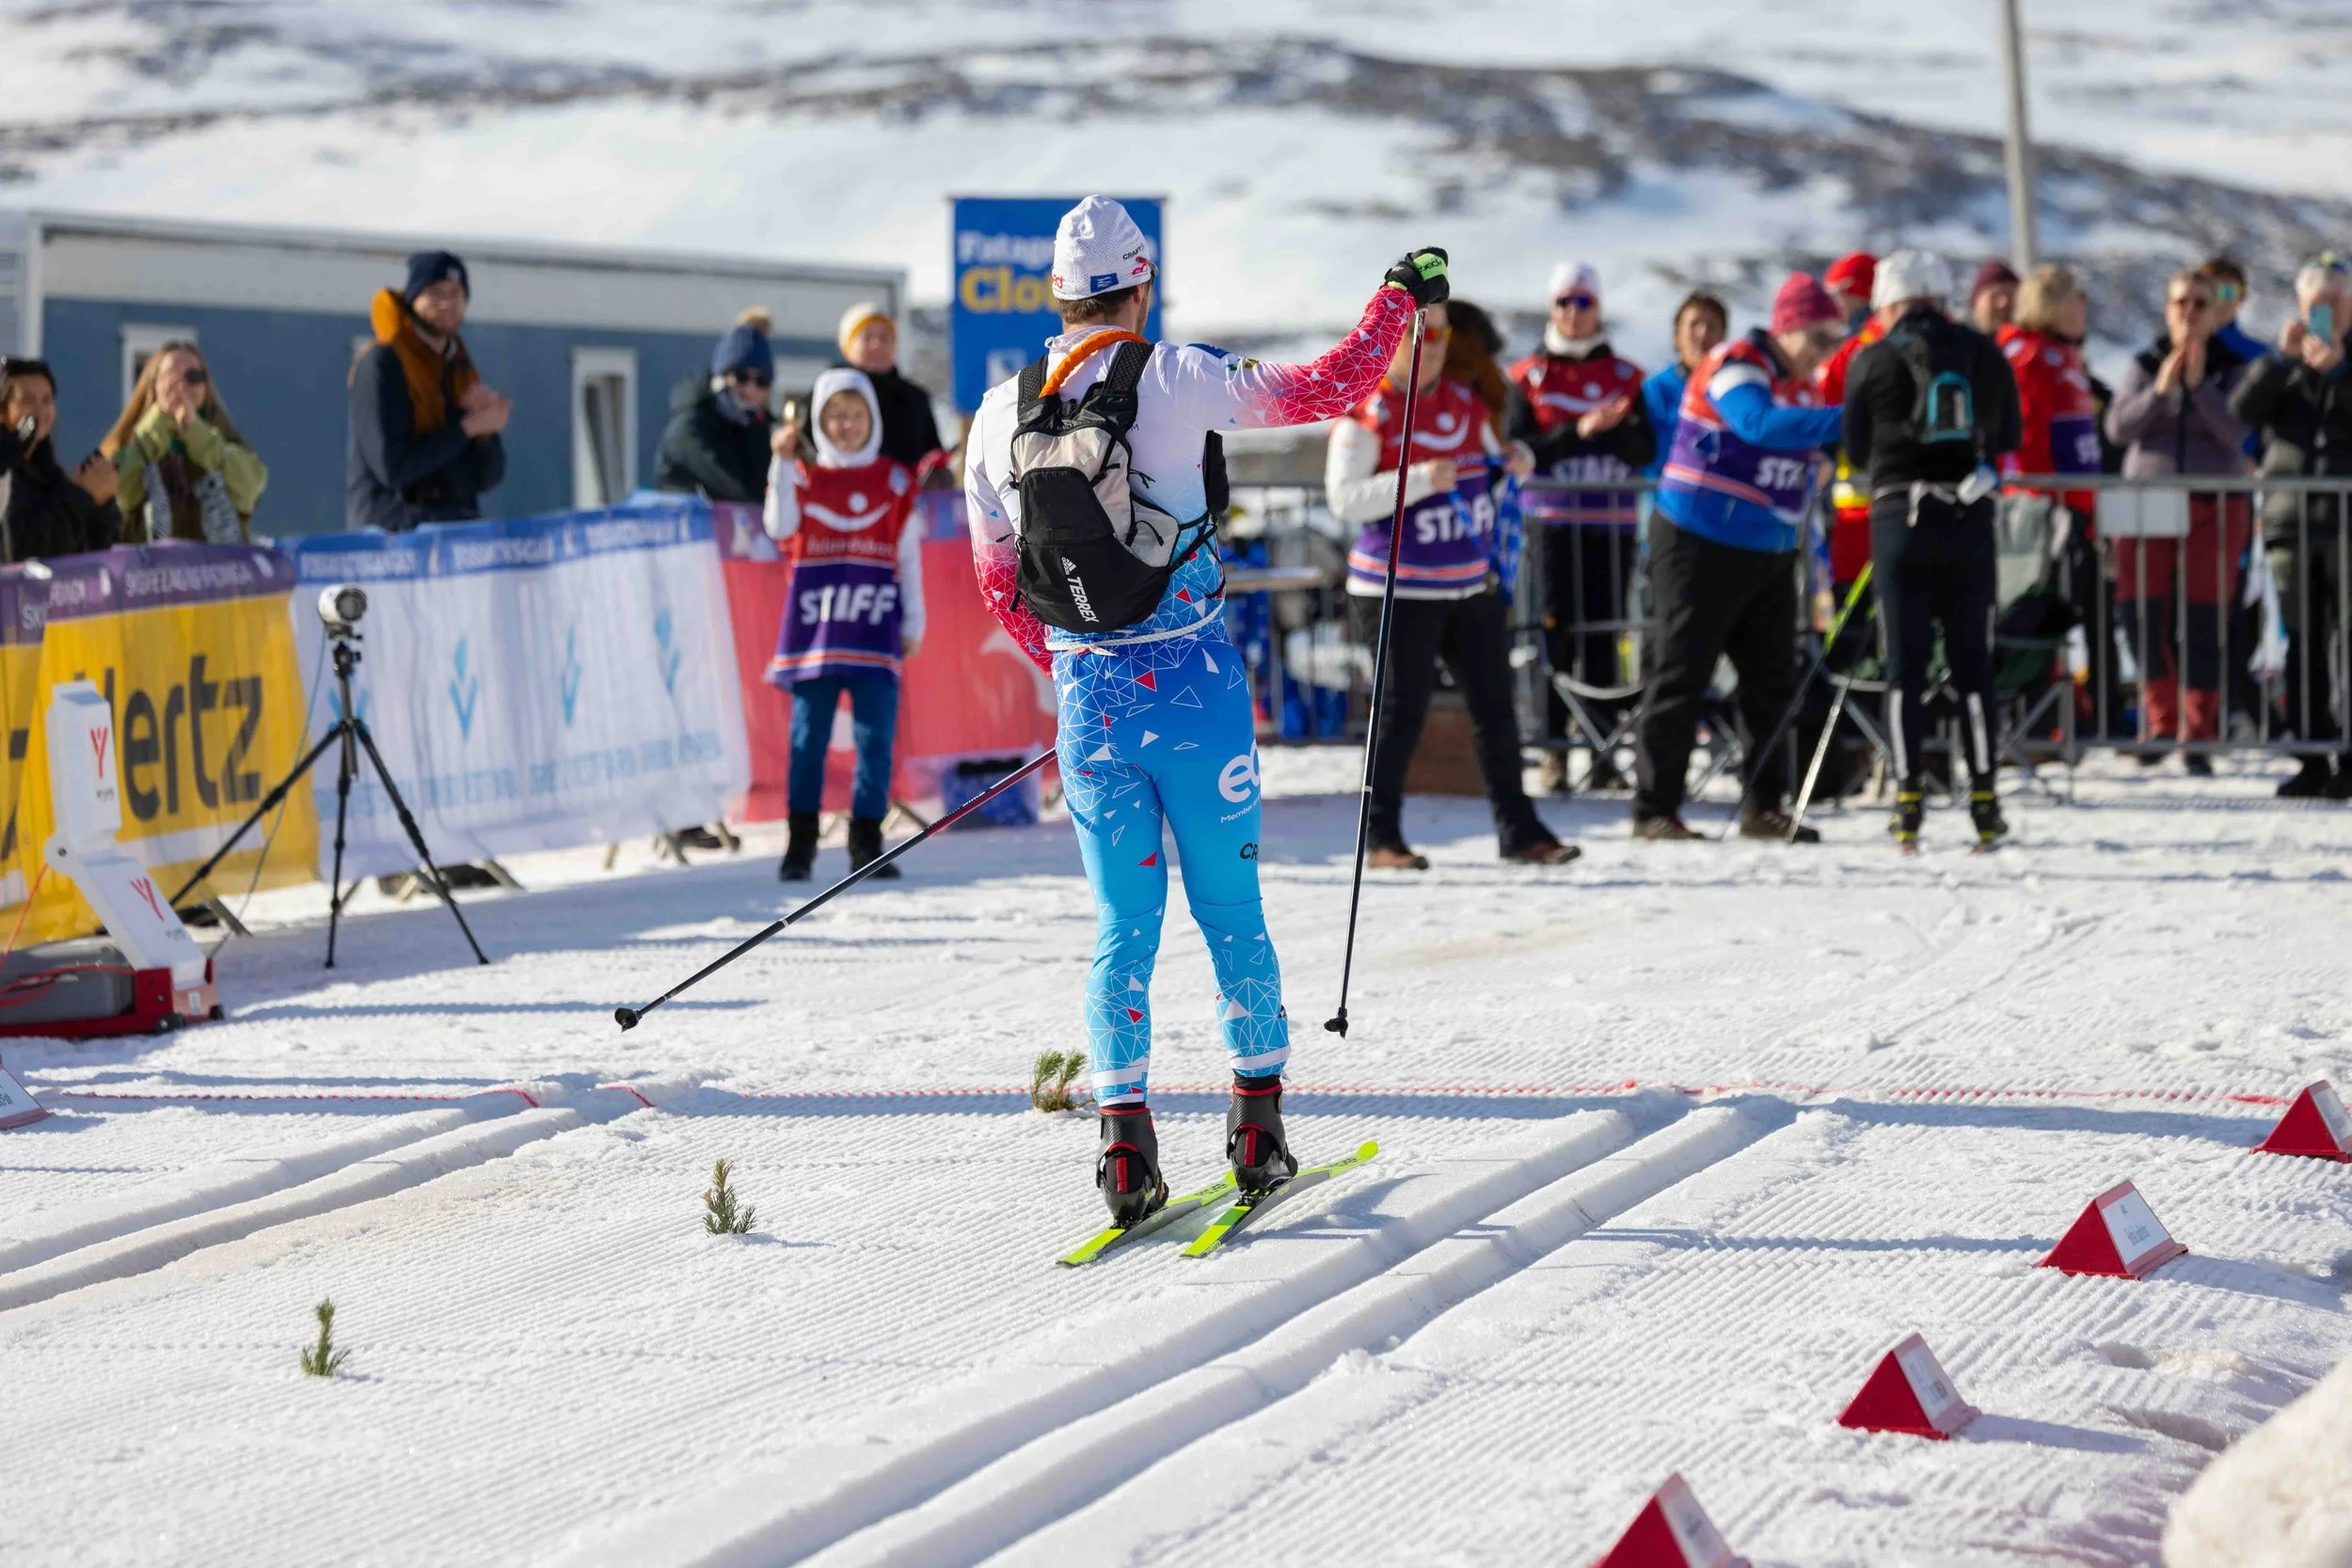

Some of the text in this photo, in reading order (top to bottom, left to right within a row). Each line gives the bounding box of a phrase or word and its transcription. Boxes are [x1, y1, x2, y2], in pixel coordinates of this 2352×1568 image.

[1122, 245, 1142, 260] CRAFT
[1067, 576, 1100, 623] TERREX
[1220, 804, 1252, 824] Member
[1239, 843, 1259, 861] CR
